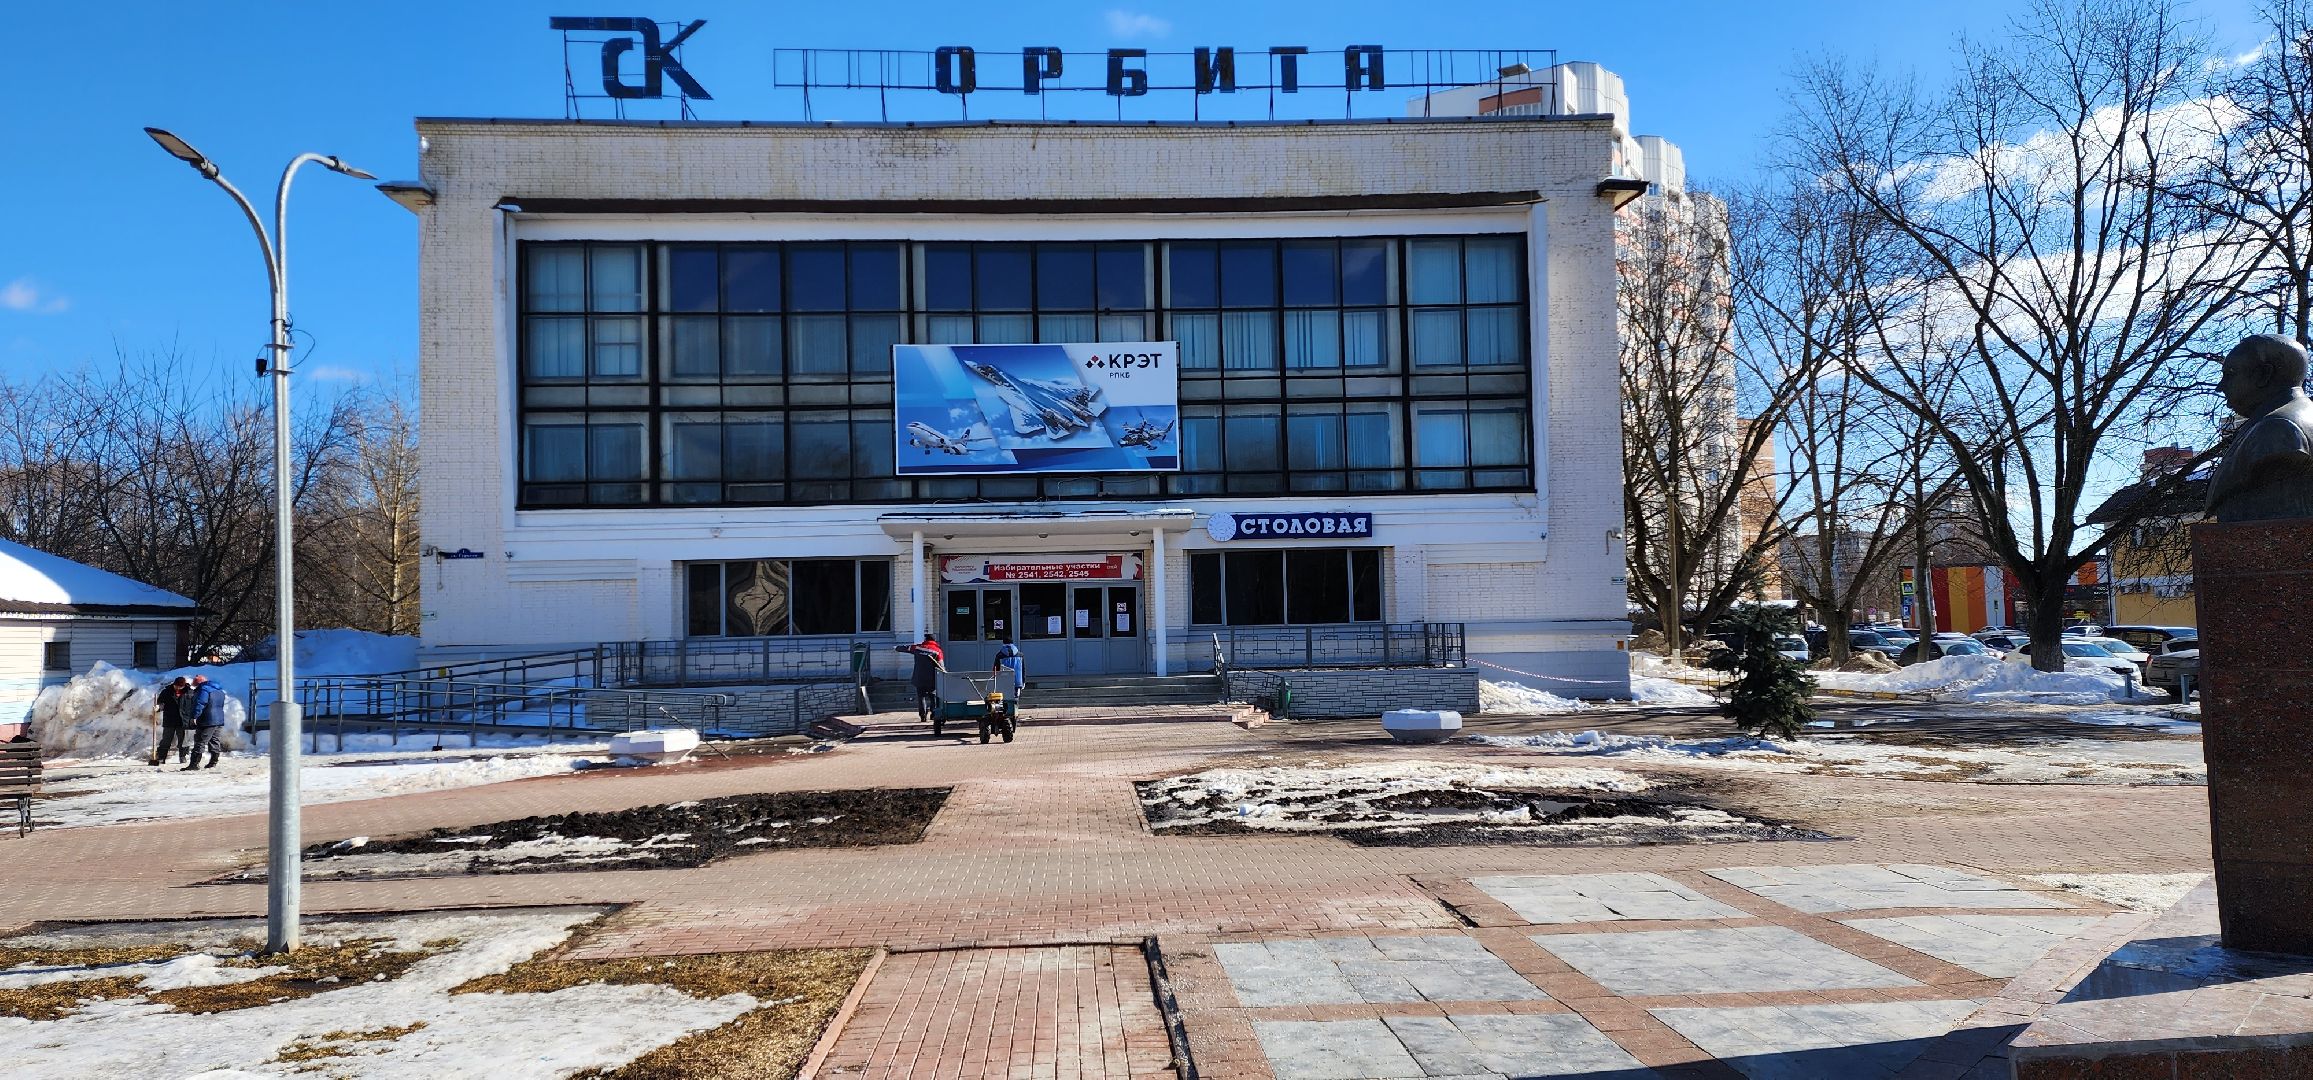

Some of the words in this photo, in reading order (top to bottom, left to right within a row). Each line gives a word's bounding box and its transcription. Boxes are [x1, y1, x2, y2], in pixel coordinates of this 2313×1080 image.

[935, 45, 1386, 96] ОРБИТА
[1109, 354, 1162, 368] КРЭТ
[1240, 517, 1367, 534] СТОЛОВАЯ
[994, 564, 1064, 572] Избирательные
[1065, 563, 1101, 571] участки
[1005, 571, 1016, 579] №
